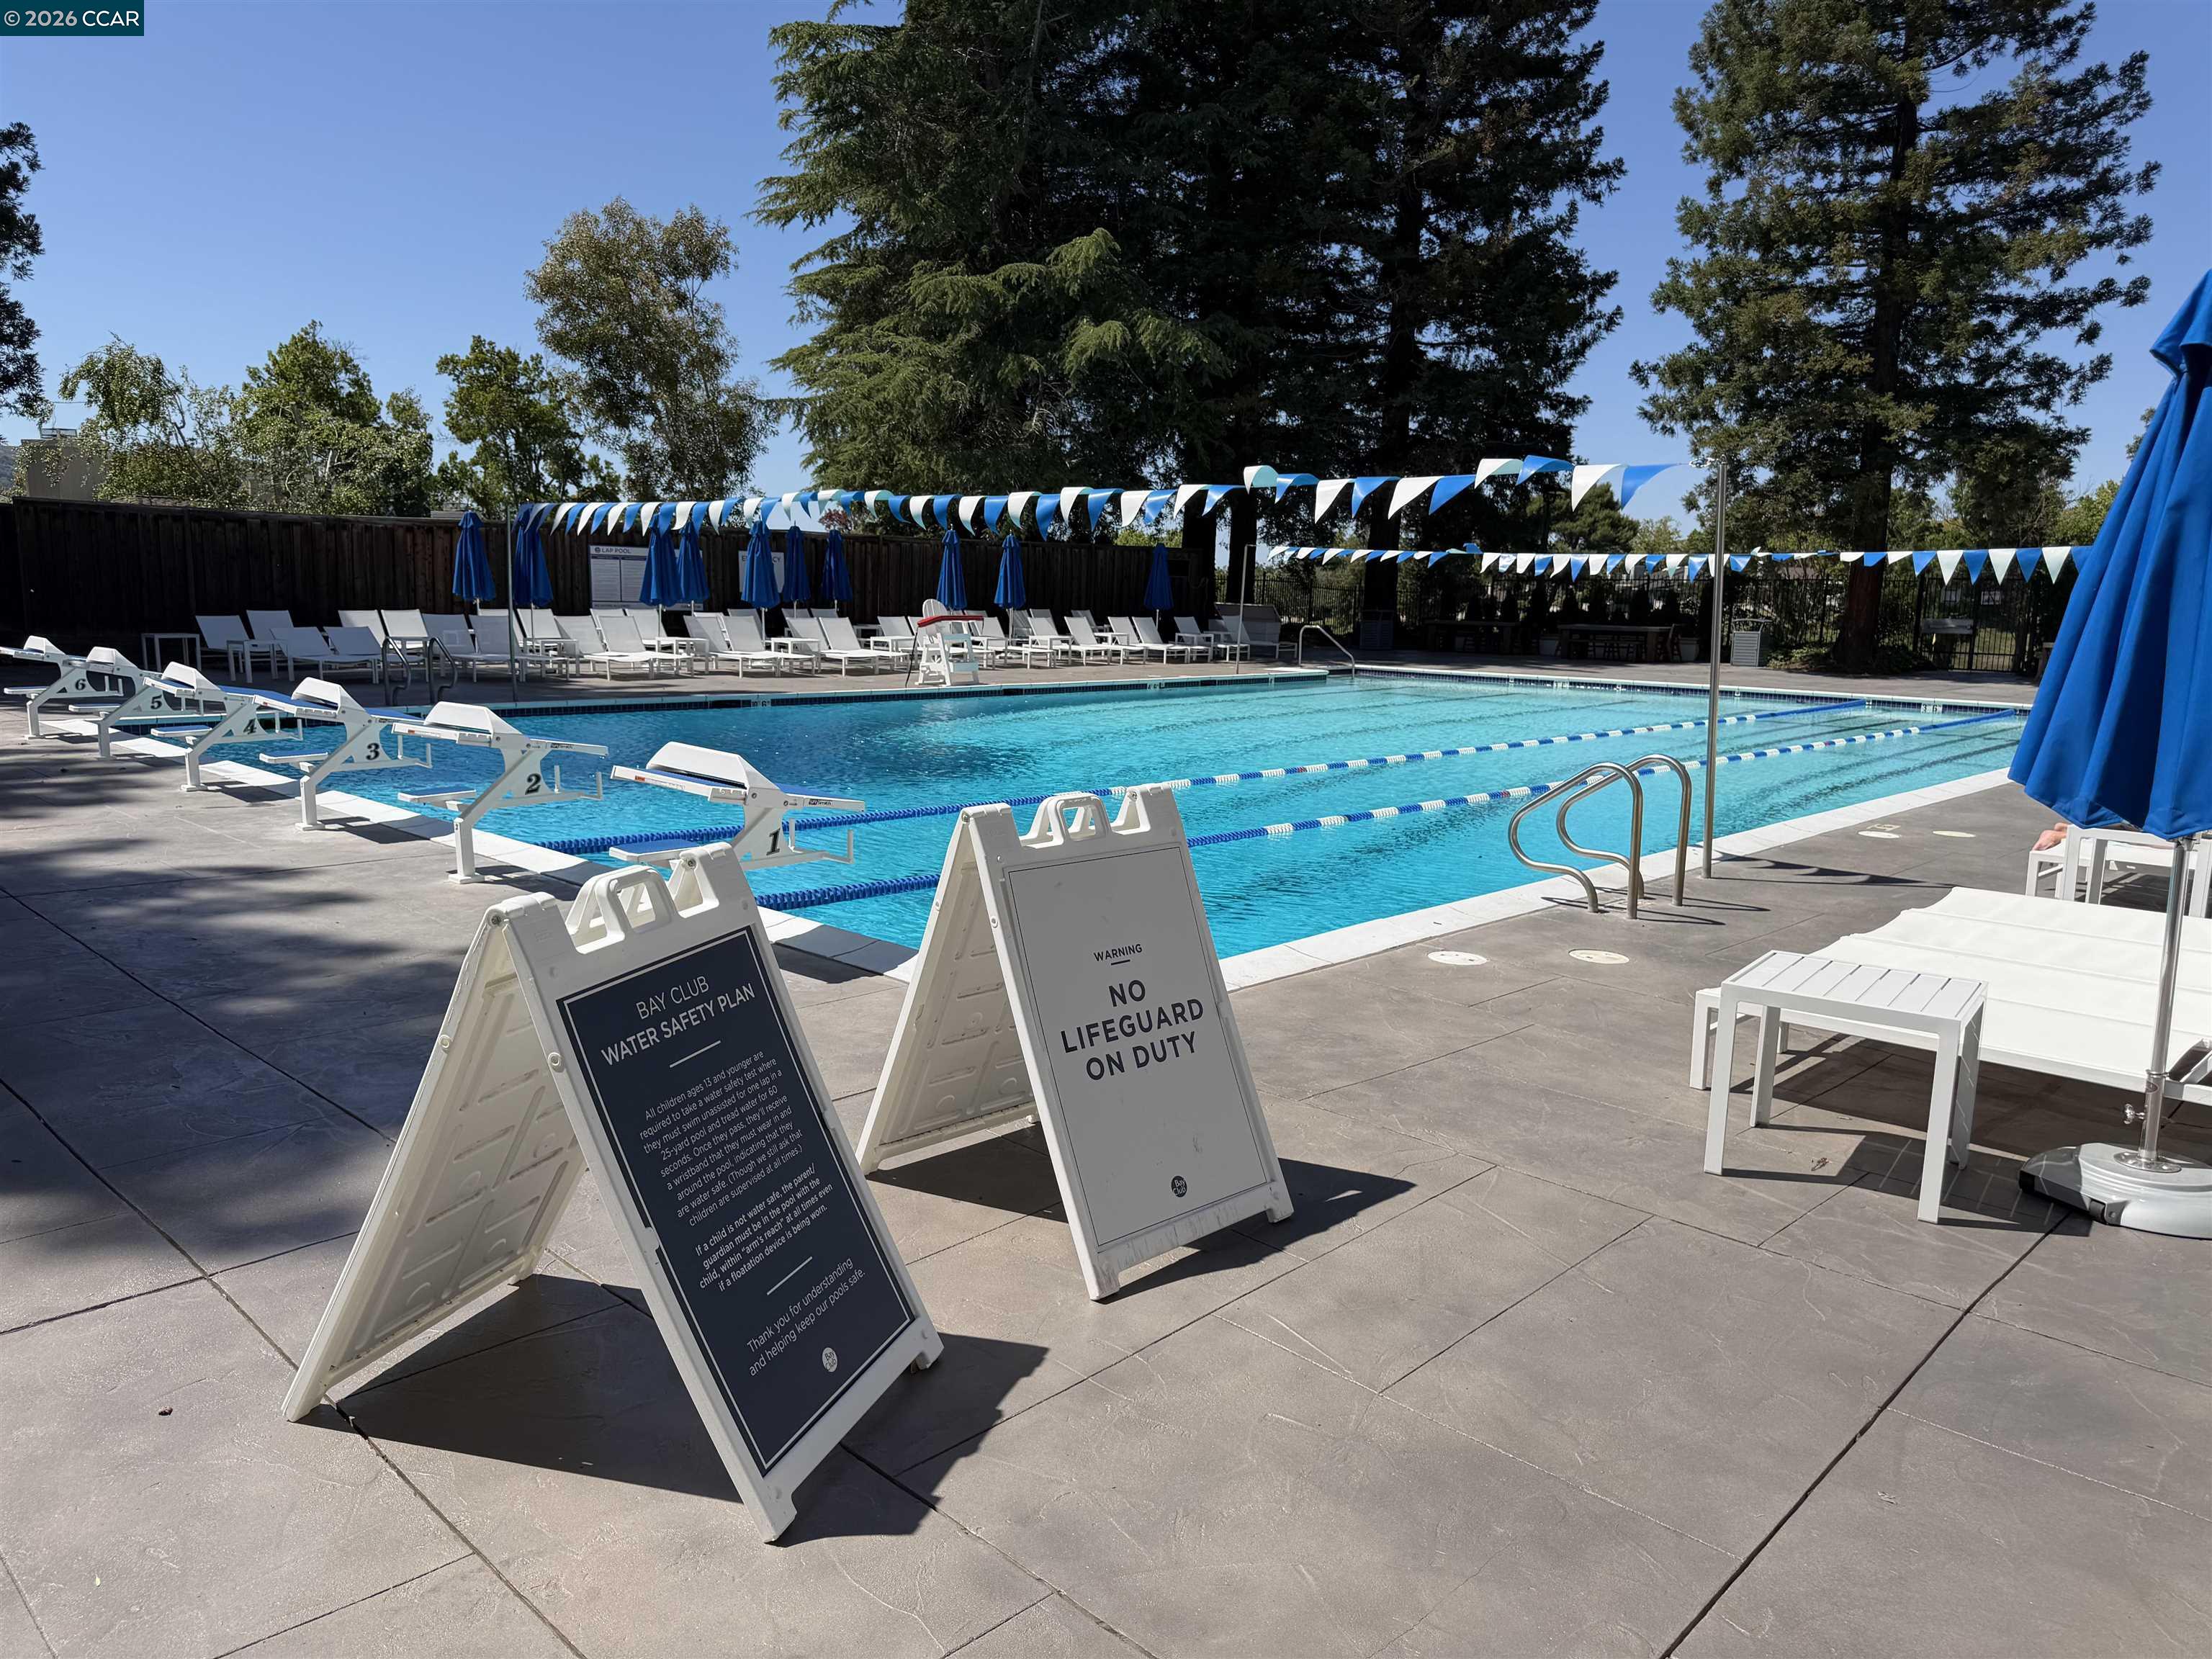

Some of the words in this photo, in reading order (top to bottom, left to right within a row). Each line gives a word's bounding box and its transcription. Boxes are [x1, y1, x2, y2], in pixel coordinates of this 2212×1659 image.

[74, 679, 86, 691] 6
[150, 695, 163, 709] 5
[243, 718, 257, 734] 4
[366, 743, 379, 761] 3
[525, 773, 541, 795] 2
[765, 828, 781, 856] 1
[1093, 943, 1142, 961] WARNING
[601, 1027, 660, 1065] WATER
[660, 999, 714, 1038] SAFETY
[716, 983, 755, 1012] PLAN
[636, 992, 666, 1020] BAY
[670, 976, 709, 1004] CLUB
[1060, 999, 1203, 1053] LIFEGUARD
[1108, 979, 1146, 1007] NO
[645, 1107, 656, 1120] All
[657, 1093, 686, 1113] children
[686, 1084, 704, 1097] ages
[703, 1077, 712, 1087] 13
[713, 1069, 726, 1083] and
[726, 1057, 752, 1077] younger
[752, 1051, 763, 1061] are
[1086, 1051, 1125, 1080] ON
[1132, 1030, 1195, 1069] DUTY
[639, 1115, 671, 1140] required
[671, 1112, 680, 1121] to
[680, 1102, 697, 1116] take
[703, 1087, 723, 1103] water
[724, 1076, 744, 1092] safety
[744, 1068, 757, 1081] test
[757, 1058, 776, 1073] where
[644, 1139, 662, 1154] they
[662, 1126, 681, 1143] must
[681, 1116, 701, 1132] swim
[701, 1094, 736, 1120] unassisted
[736, 1089, 746, 1100] for
[747, 1082, 760, 1094] one
[759, 1076, 770, 1087] lap
[660, 1136, 690, 1160] 25-yard
[690, 1126, 706, 1144] pool
[707, 1118, 721, 1133] and
[720, 1107, 739, 1124] tread
[739, 1097, 757, 1113] water
[757, 1092, 768, 1102] for
[768, 1085, 778, 1096] 60
[660, 1154, 693, 1177] seconds.
[693, 1141, 712, 1156] Once
[712, 1131, 728, 1145] they
[765, 1095, 787, 1112] receive
[673, 1157, 709, 1186] wristband
[709, 1148, 724, 1163] that
[724, 1139, 739, 1154] they
[739, 1128, 757, 1143] must
[756, 1118, 772, 1133] wear
[773, 1115, 780, 1123] in
[779, 1105, 792, 1119] and
[677, 1177, 703, 1200] around
[702, 1172, 716, 1183] the
[733, 1139, 766, 1163] indicating
[765, 1129, 779, 1143] that
[778, 1121, 793, 1134] they
[677, 1205, 690, 1218] are
[690, 1190, 710, 1208] water
[711, 1180, 728, 1195] safe.
[728, 1159, 756, 1184] (Though
[756, 1154, 766, 1164] we
[766, 1143, 778, 1158] still
[778, 1137, 790, 1150] ask
[788, 1129, 802, 1142] that
[688, 1202, 719, 1226] children
[718, 1194, 730, 1207] are
[730, 1167, 765, 1198] supervised
[765, 1163, 773, 1174] at
[773, 1156, 782, 1169] all
[695, 1244, 702, 1256] If
[709, 1227, 727, 1246] child
[726, 1224, 734, 1233] is
[734, 1214, 747, 1228] not
[747, 1201, 765, 1218] water
[766, 1191, 783, 1205] safe,
[781, 1182, 793, 1194] the
[793, 1162, 815, 1187] parent/
[1173, 1186, 1186, 1195] Club
[699, 1268, 721, 1288] child,
[719, 1252, 742, 1272] within
[785, 1213, 793, 1223] at
[793, 1205, 801, 1218] all
[801, 1195, 818, 1211] times
[818, 1184, 833, 1198] even
[703, 1241, 734, 1270] guardian
[734, 1226, 752, 1245] must
[751, 1220, 762, 1232] be
[760, 1215, 770, 1224] in
[768, 1207, 781, 1219] the
[781, 1193, 796, 1212] pool
[795, 1184, 810, 1199] with
[809, 1177, 820, 1189] the
[718, 1280, 725, 1291] if
[730, 1252, 765, 1282] floatation
[764, 1236, 786, 1256] device
[784, 1230, 792, 1239] is
[791, 1216, 811, 1234] being
[809, 1205, 827, 1220] worn.
[746, 1326, 775, 1352] Thank
[773, 1313, 790, 1333] you
[788, 1301, 801, 1317] for
[801, 1258, 853, 1305] understanding
[749, 1353, 767, 1376] and
[765, 1330, 797, 1360] helping
[794, 1313, 815, 1334] keep
[815, 1300, 828, 1316] our
[828, 1282, 849, 1306] pools
[848, 1269, 866, 1286] safe.
